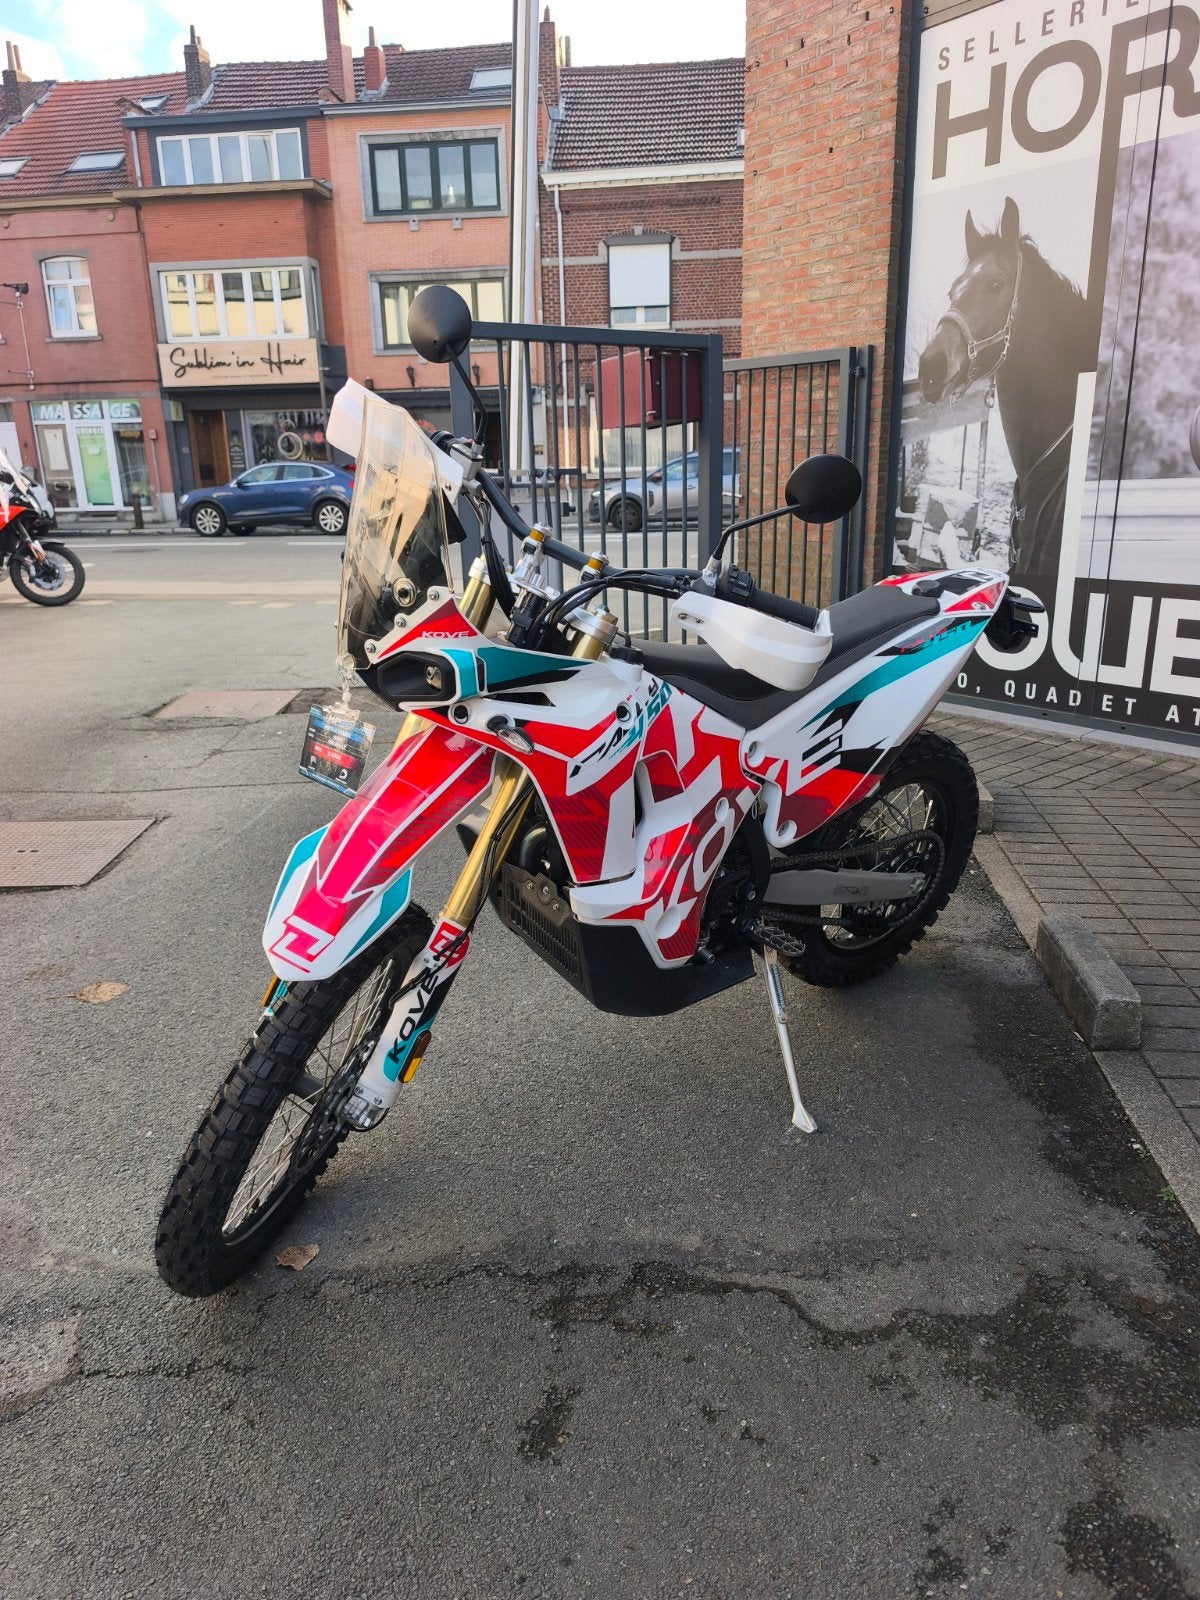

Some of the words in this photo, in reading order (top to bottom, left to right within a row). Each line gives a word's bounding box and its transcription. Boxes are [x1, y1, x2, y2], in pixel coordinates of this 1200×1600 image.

[260, 342, 306, 375] Hair
[421, 630, 470, 638] KOVE
[1004, 679, 1081, 707] QUAD
[1101, 694, 1137, 715] ET
[387, 970, 439, 1064] KOVE
